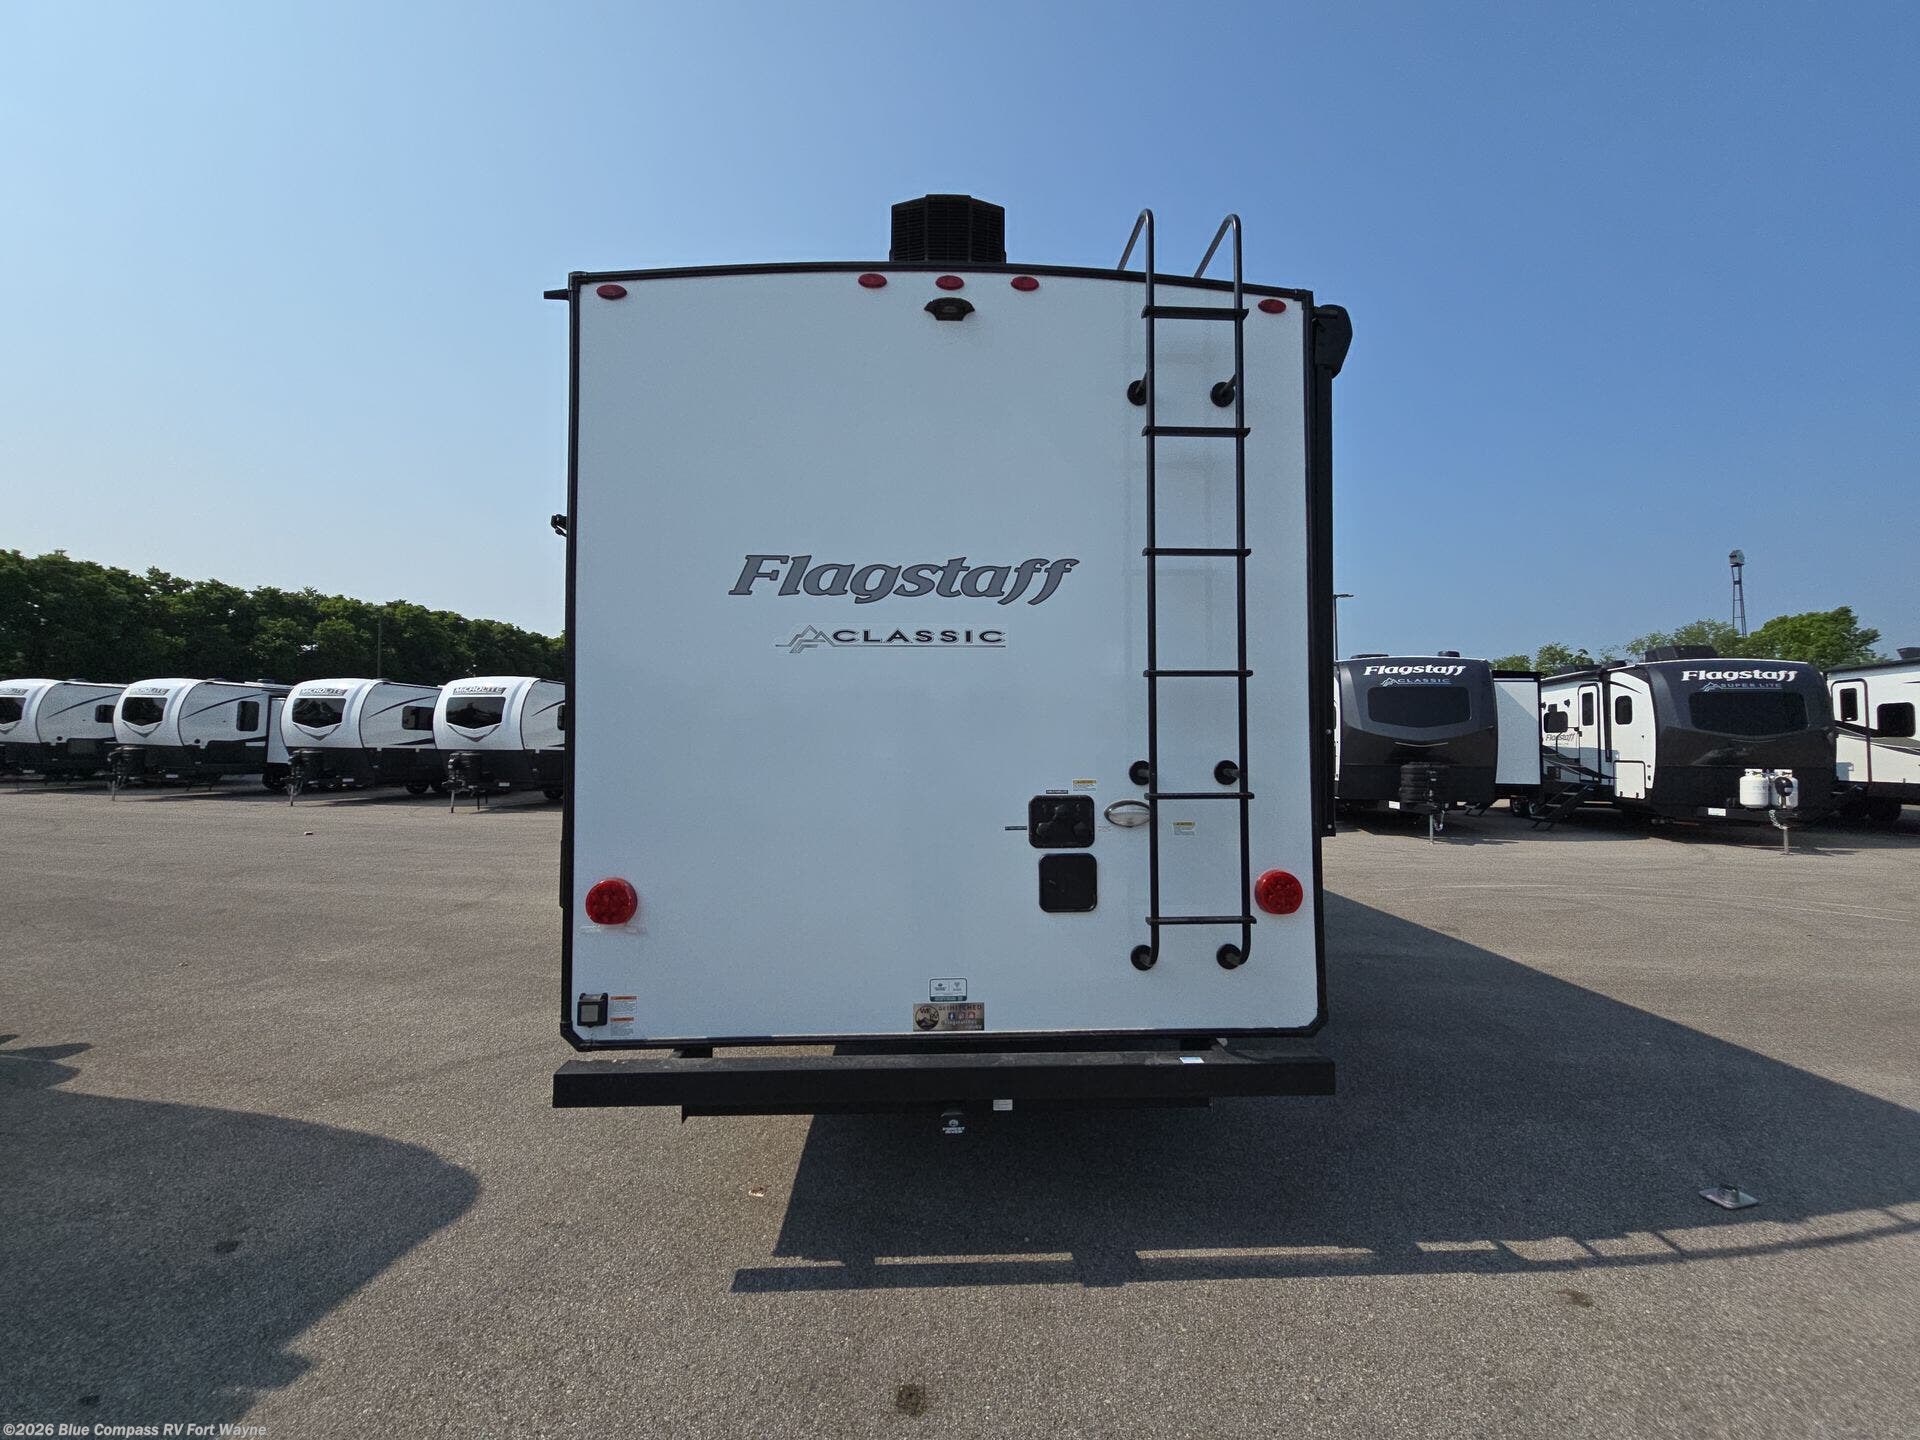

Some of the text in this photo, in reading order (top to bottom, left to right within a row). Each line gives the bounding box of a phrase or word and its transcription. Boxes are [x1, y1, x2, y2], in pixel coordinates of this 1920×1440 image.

[728, 553, 1080, 606] Flagstaff
[832, 628, 1006, 645] CLASSIC
[1363, 664, 1466, 676] Flagstaff
[1681, 669, 1798, 682] Flagstaff
